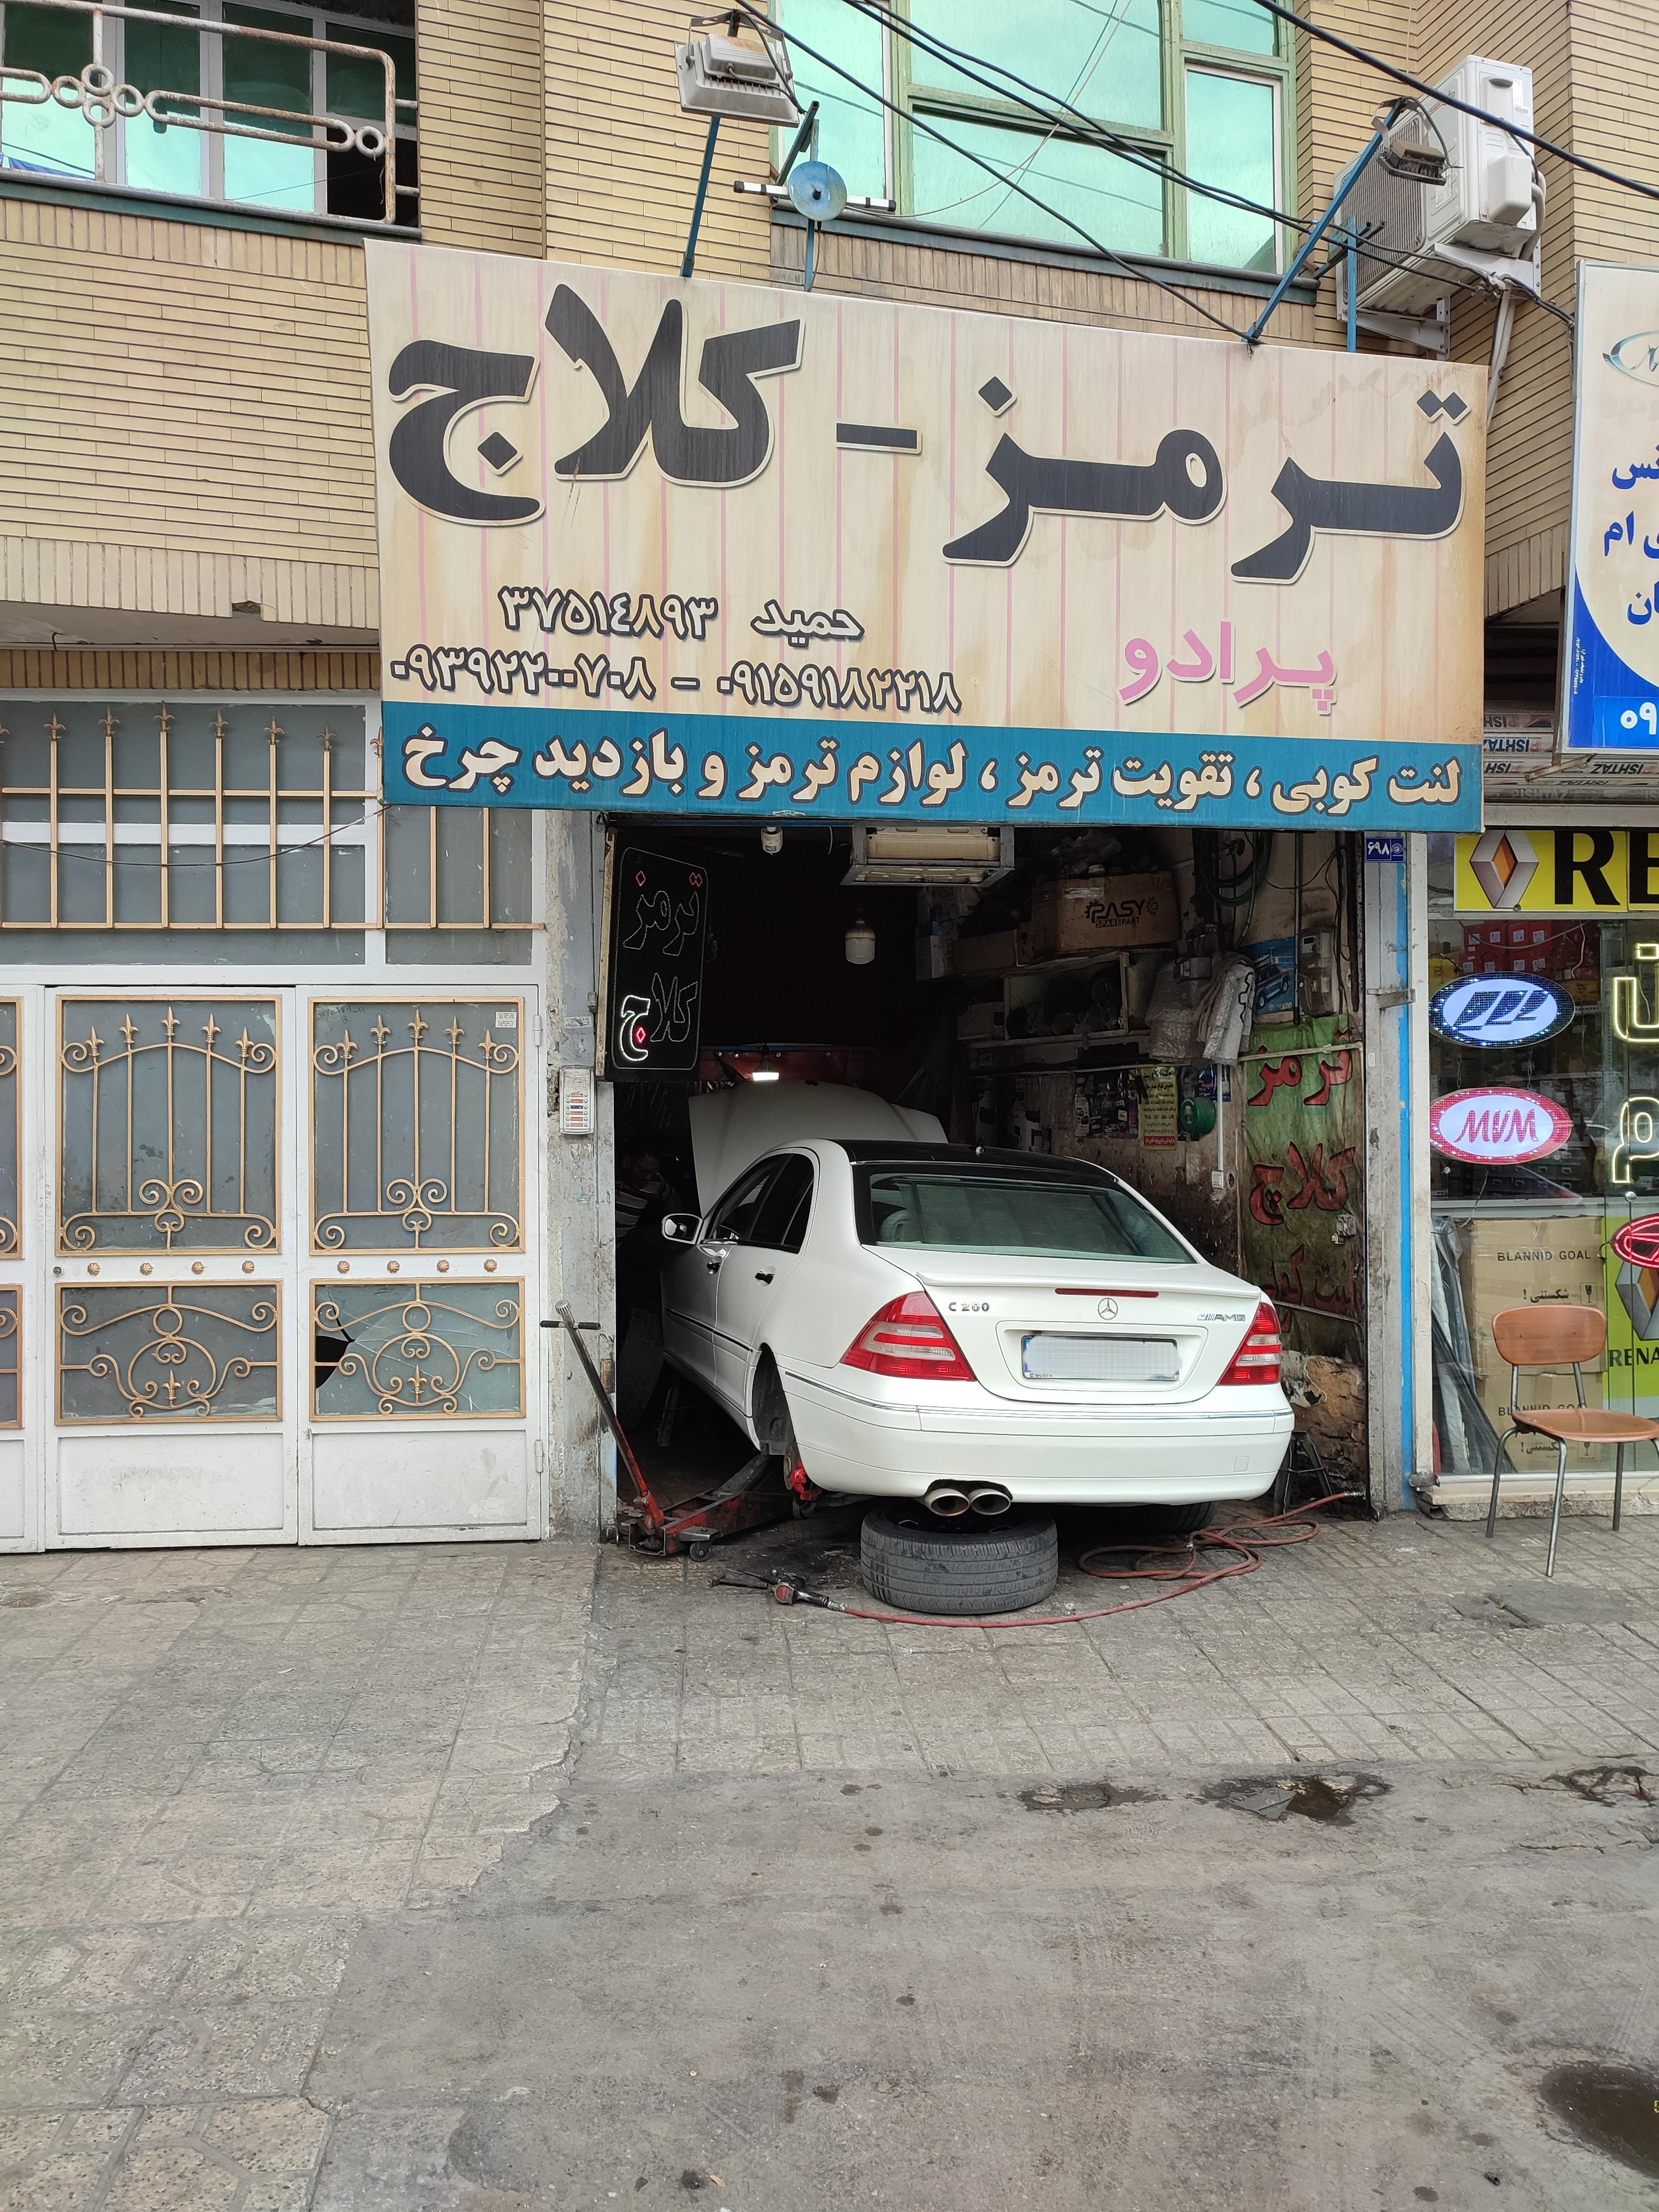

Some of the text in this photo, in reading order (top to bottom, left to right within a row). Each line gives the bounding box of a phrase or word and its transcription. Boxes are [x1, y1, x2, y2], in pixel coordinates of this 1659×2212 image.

[388, 283, 804, 524] کلاج
[942, 375, 1468, 583] ترمز
[750, 599, 865, 647] حمید
[1118, 621, 1337, 714] پرادو
[401, 722, 523, 795] چرخ
[533, 727, 687, 798] بازدید
[696, 750, 728, 800] و
[735, 736, 840, 804] ترمز
[848, 737, 969, 807] لوازم
[1005, 745, 1105, 810] ترمز
[1113, 749, 1235, 811] تقویت
[1271, 755, 1380, 816] کوبی
[1387, 756, 1463, 806] لنت
[1368, 841, 1390, 855] ۶۹۸
[622, 870, 703, 956] ترمز
[1096, 916, 1140, 928] SPAREPART
[1247, 1027, 1354, 1107] ترمز
[1454, 1108, 1538, 1144] MVM
[1498, 1250, 1591, 1261] BLANNID GOAL
[948, 1302, 990, 1312] C 200
[1530, 1288, 1569, 1303] شکستنی
